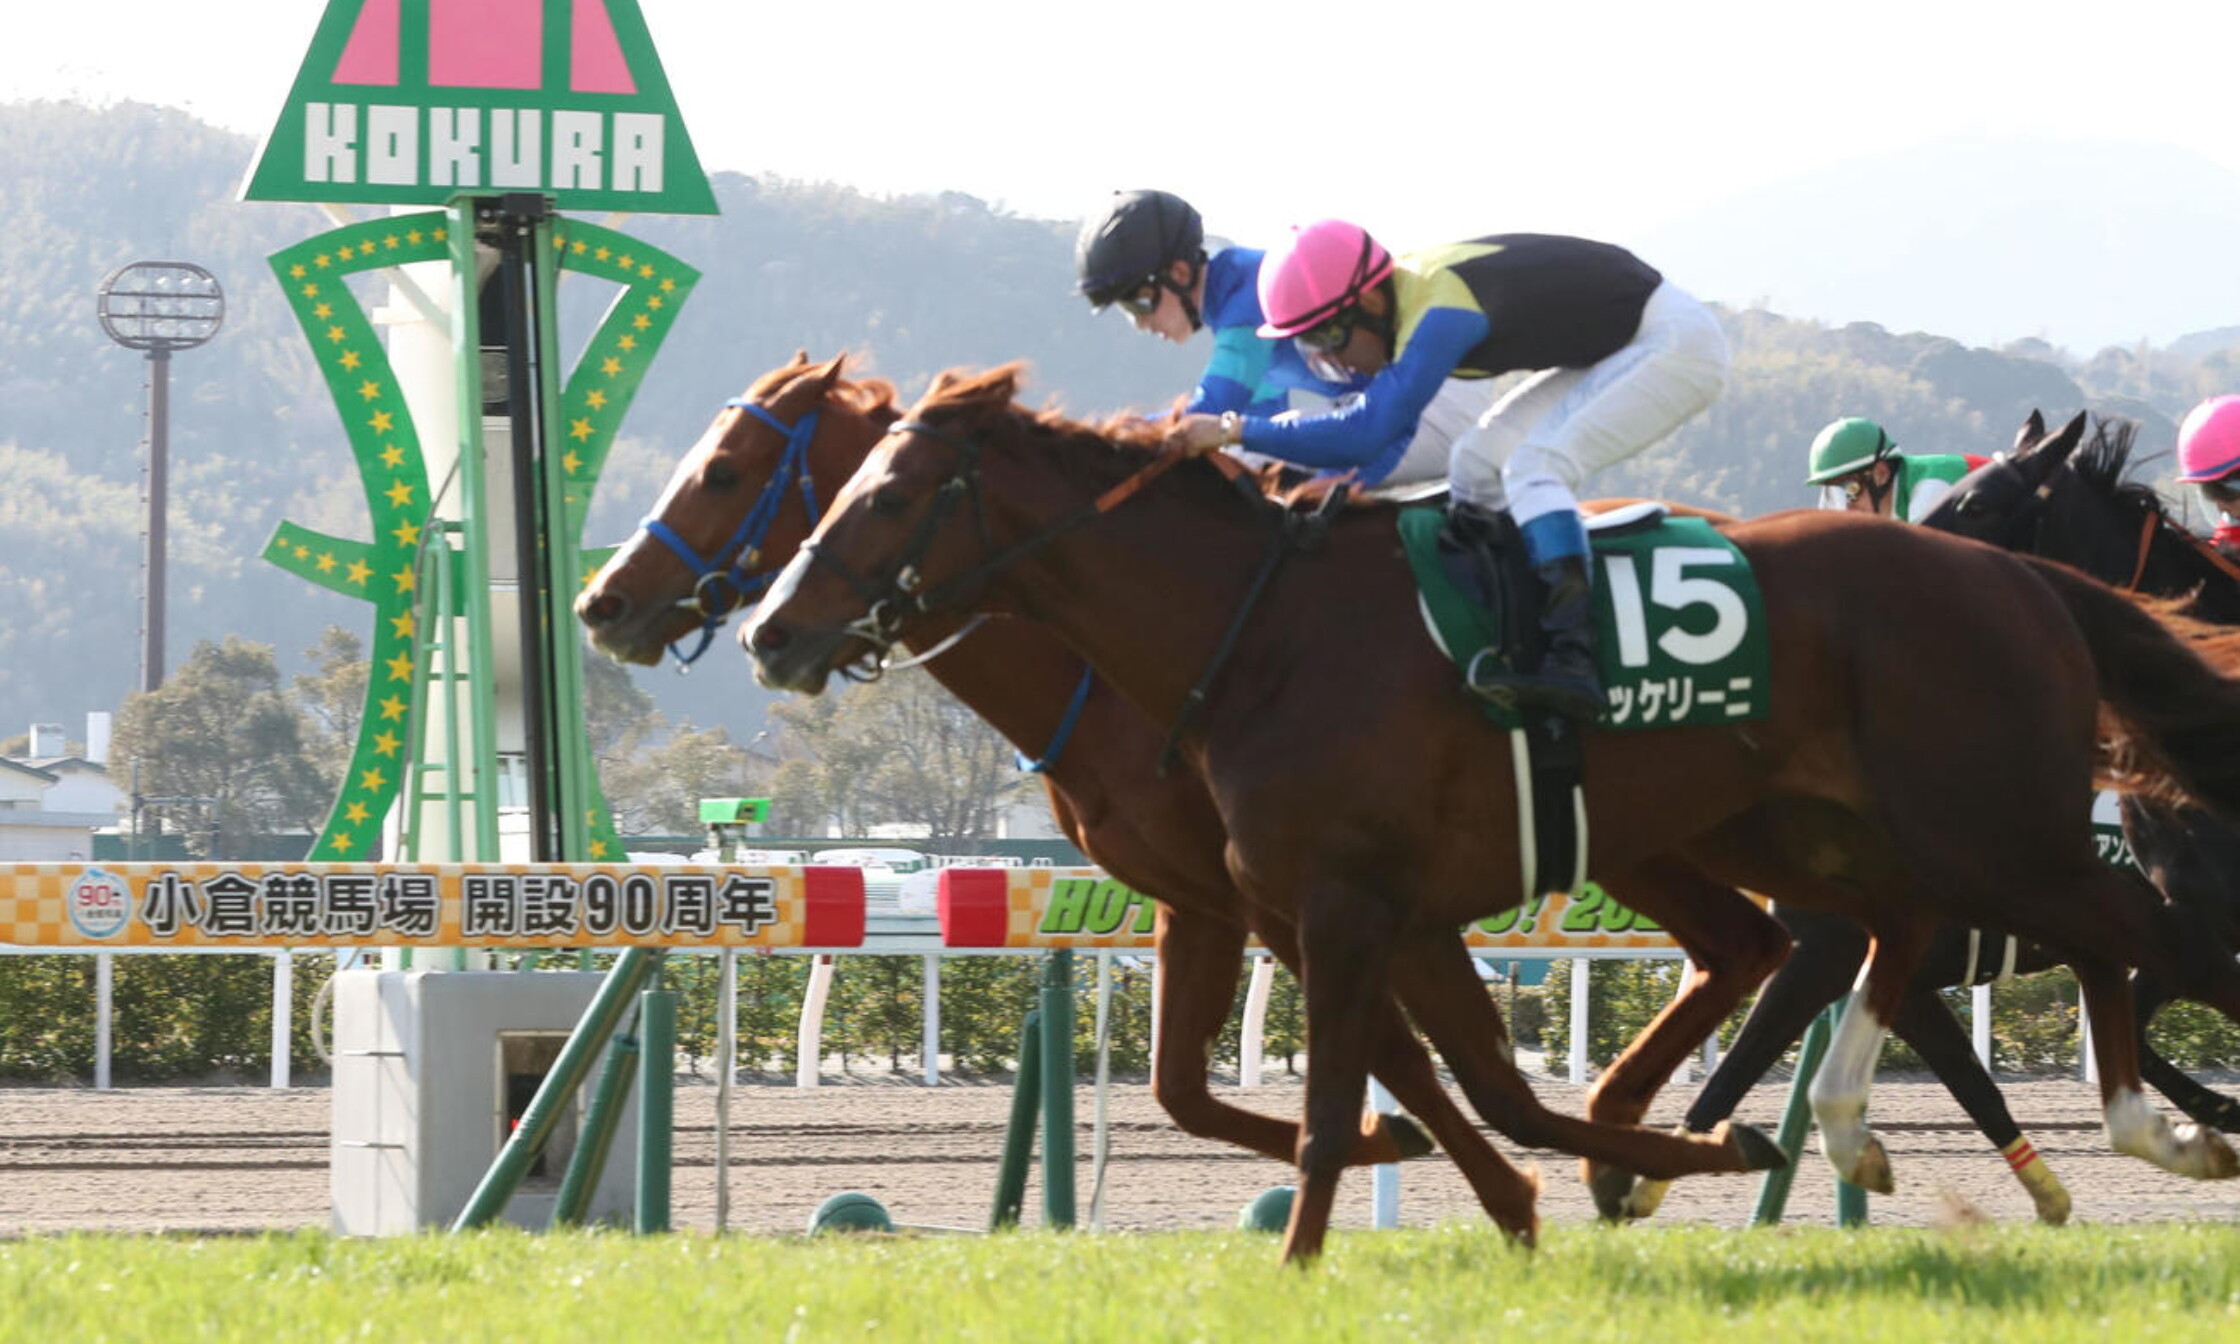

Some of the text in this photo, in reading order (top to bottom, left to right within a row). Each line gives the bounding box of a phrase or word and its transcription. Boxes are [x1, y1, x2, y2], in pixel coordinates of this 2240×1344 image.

[305, 102, 664, 192] KOKURA
[1605, 547, 1747, 667] 15
[1600, 676, 1752, 724] ッケリーニ
[142, 872, 775, 935] 小倉競馬場 開設90周年
